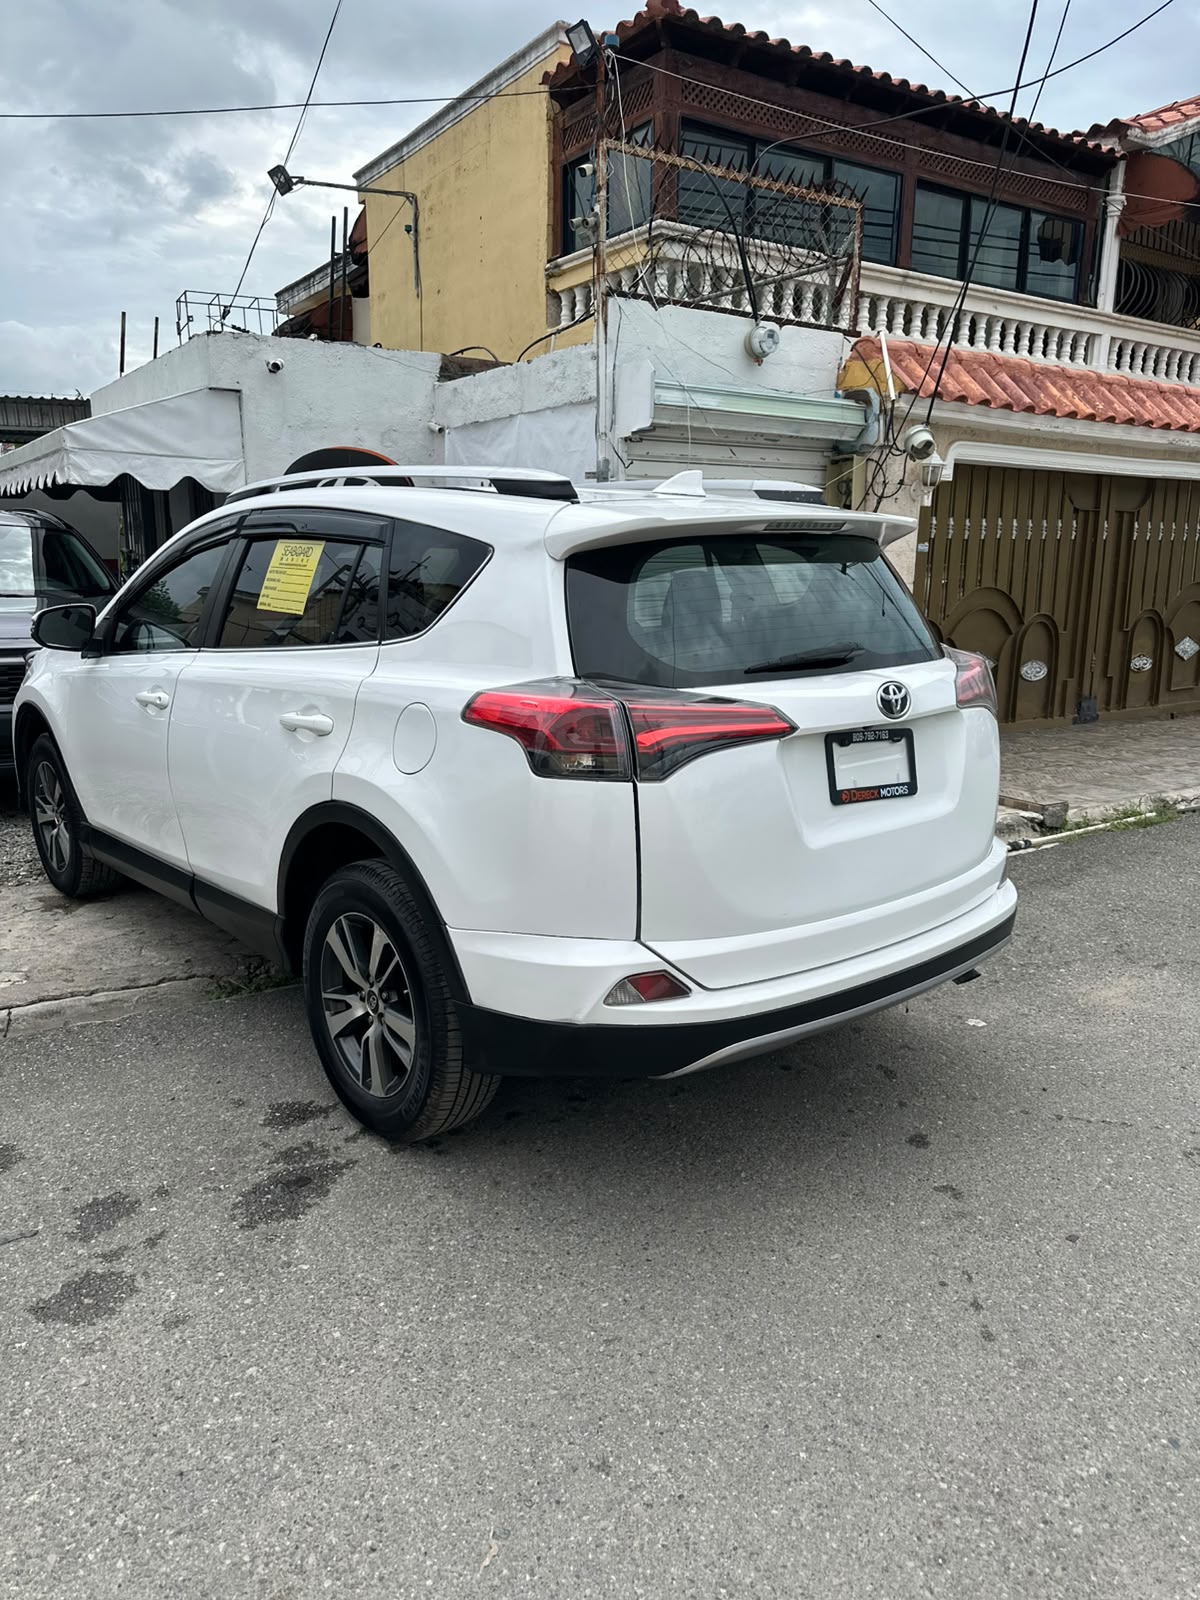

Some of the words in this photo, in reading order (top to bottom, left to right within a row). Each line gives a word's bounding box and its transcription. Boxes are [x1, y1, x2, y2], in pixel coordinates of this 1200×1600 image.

[281, 545, 314, 557] SEABOARD
[851, 789, 880, 801] DERECK
[880, 786, 909, 798] MOTORS
